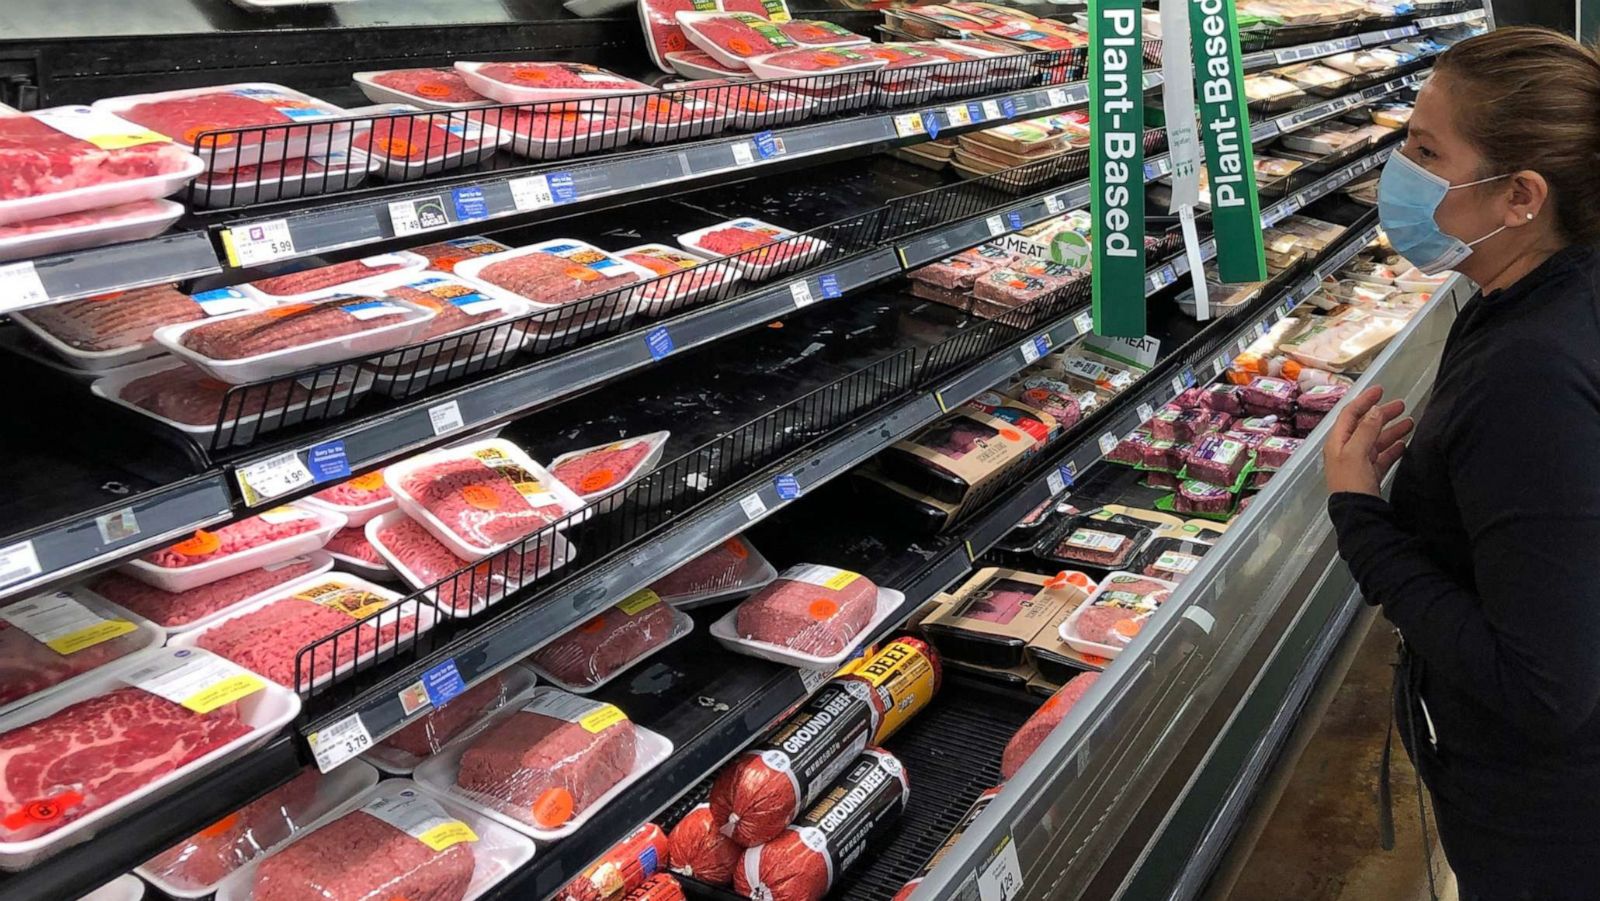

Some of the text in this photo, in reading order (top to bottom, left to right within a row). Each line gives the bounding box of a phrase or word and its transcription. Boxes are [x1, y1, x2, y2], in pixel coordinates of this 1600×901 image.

[1193, 0, 1245, 207] Plant-Based
[1103, 9, 1137, 258] Plant-Based
[271, 240, 292, 254] 5.99
[1007, 237, 1045, 257] MEAT
[284, 469, 304, 485] 4.99
[865, 644, 911, 678] BEEF
[783, 710, 832, 754] GROUND
[828, 691, 852, 718] BEEF
[345, 734, 368, 753] 3.79
[821, 786, 864, 833] GROUND
[859, 764, 888, 797] BEEF
